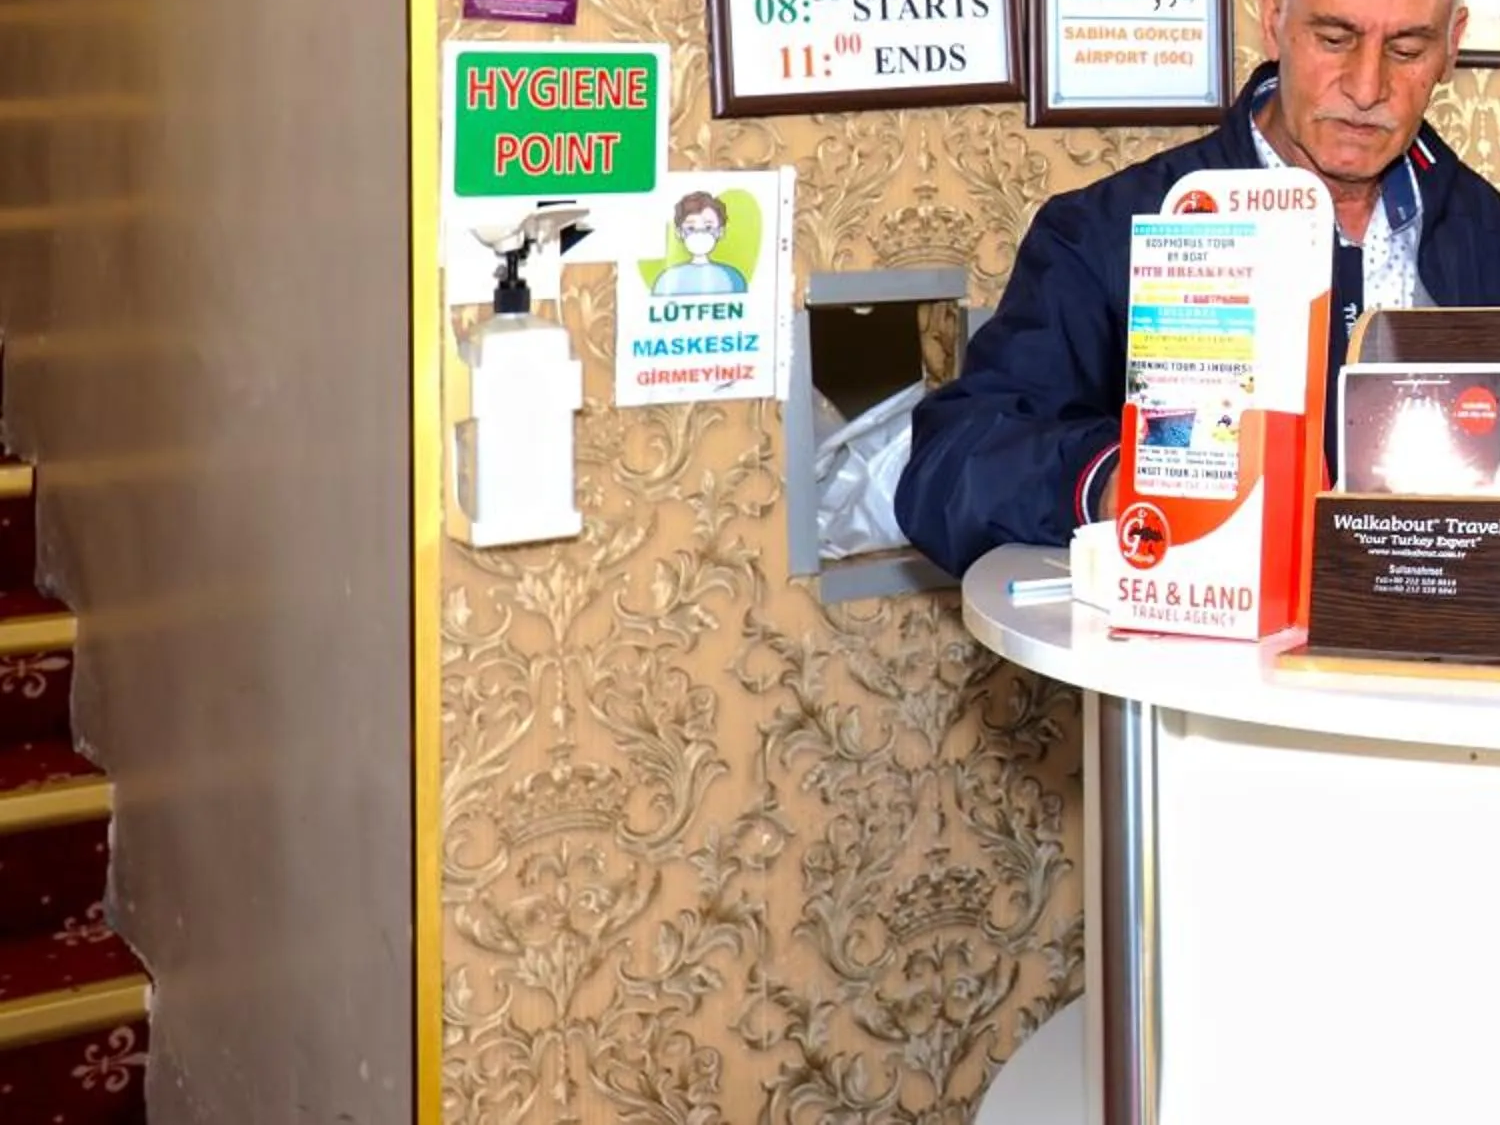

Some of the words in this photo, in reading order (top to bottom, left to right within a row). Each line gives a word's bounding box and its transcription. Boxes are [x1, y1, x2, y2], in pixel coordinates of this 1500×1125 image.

[1063, 24, 1128, 41] SABİHA
[780, 32, 862, 80] 11:00
[875, 43, 968, 76] ENDS
[1074, 48, 1149, 66] AİRPORT
[467, 67, 648, 110] HYGIENE
[494, 133, 620, 175] POINT
[1229, 190, 1240, 212] 5
[1246, 187, 1318, 211] HOURS
[648, 301, 744, 323] LÜTFEN
[632, 331, 760, 358] MASKESİZ
[636, 364, 757, 387] GİRMEYİNİZ
[1391, 534, 1434, 548] Turkey
[1117, 577, 1159, 604] SEA
[1165, 581, 1182, 606] &
[1189, 583, 1253, 612] LAND
[1131, 603, 1180, 623] TRAVEL
[1184, 607, 1237, 628] AGENCY
